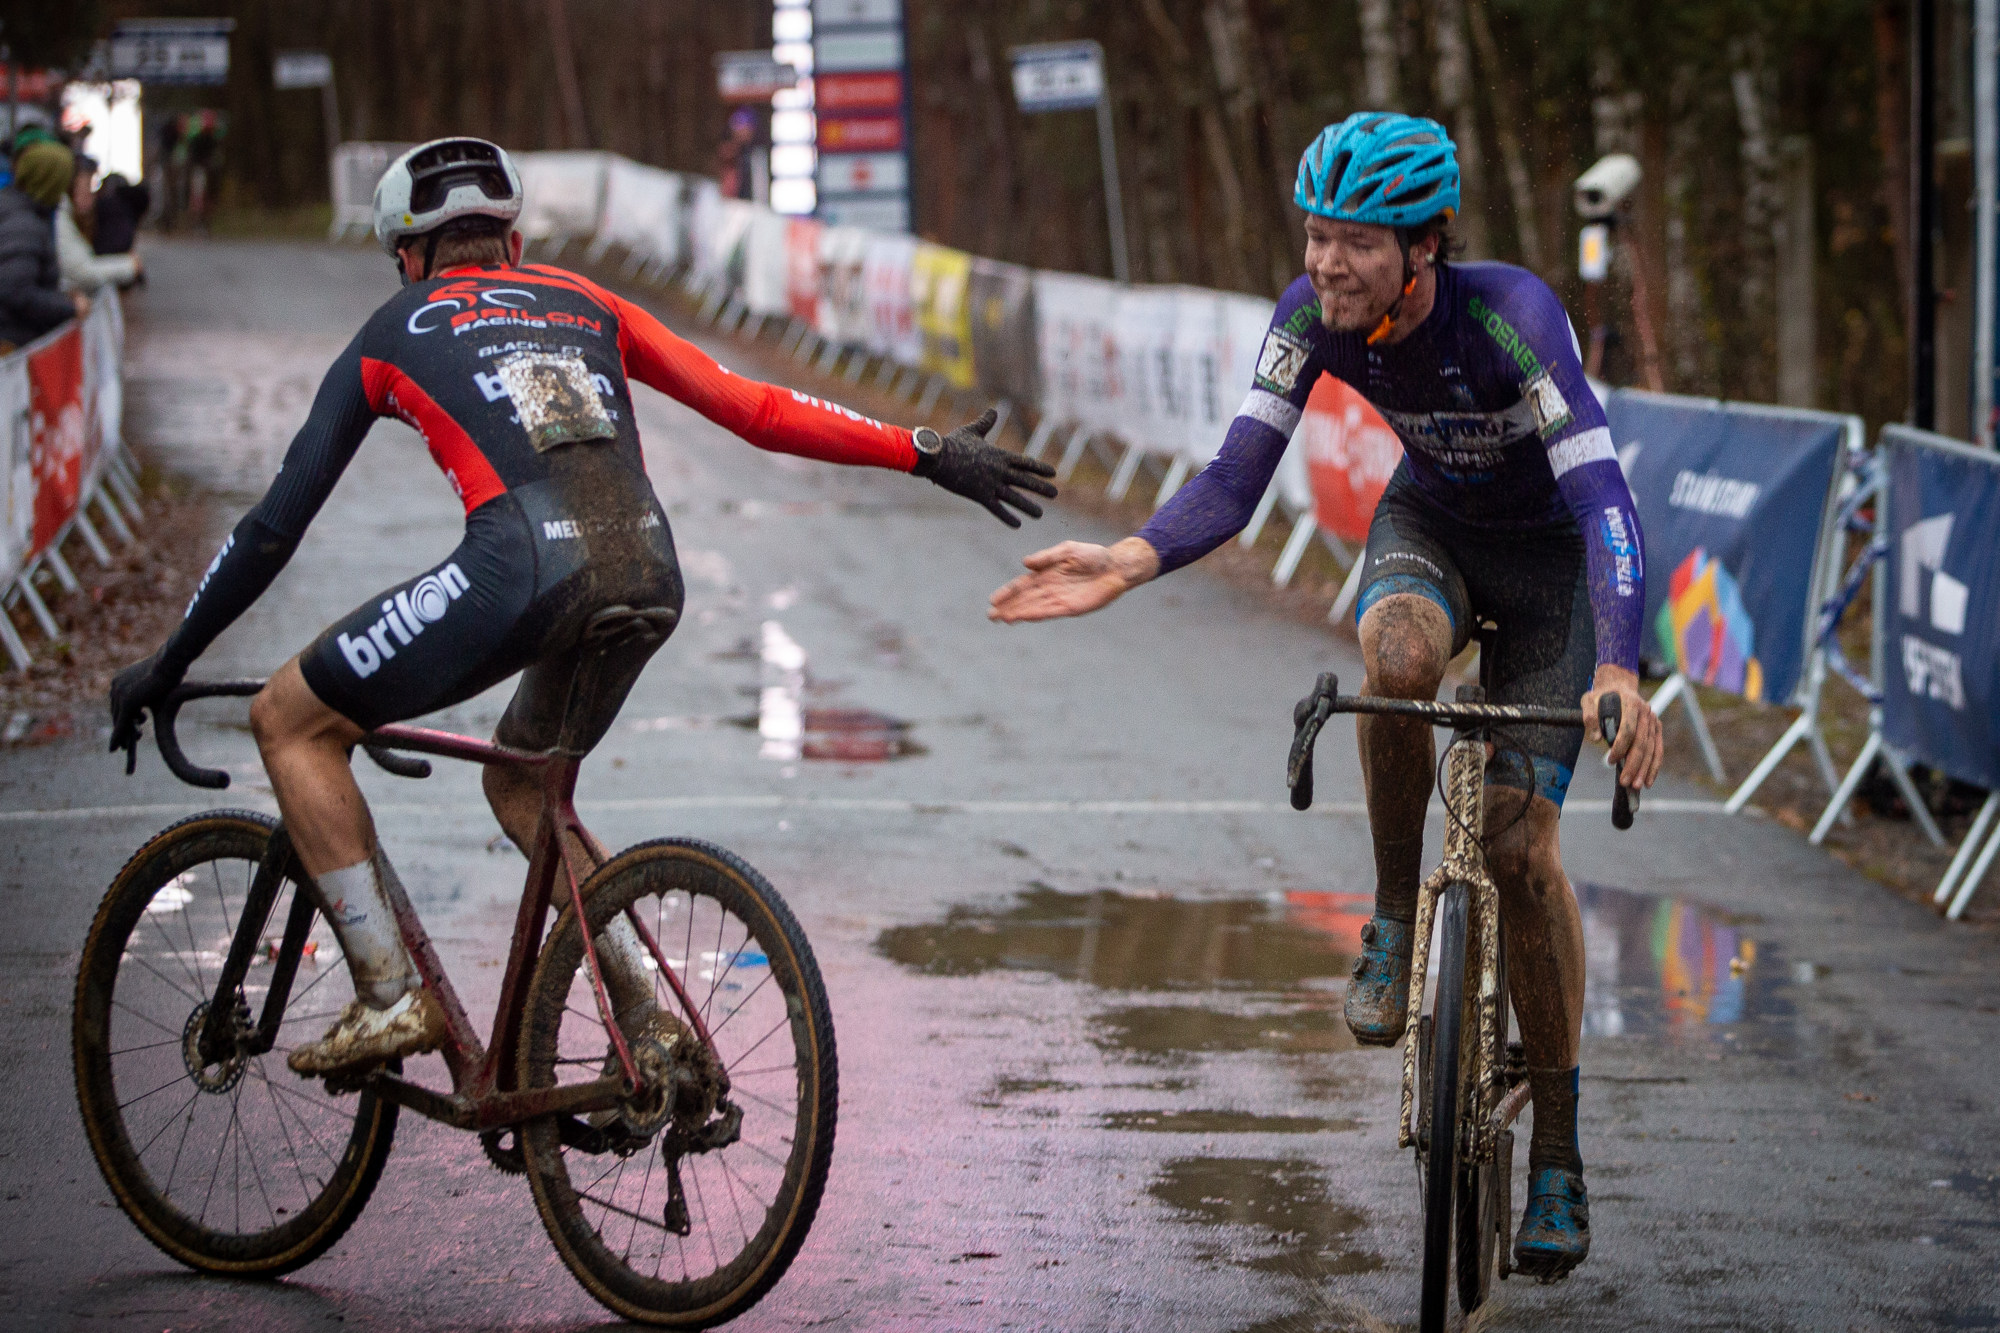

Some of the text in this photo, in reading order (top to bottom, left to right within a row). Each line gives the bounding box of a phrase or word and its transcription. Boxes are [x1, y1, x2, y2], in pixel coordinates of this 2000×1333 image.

[450, 307, 602, 332] BRILON
[453, 317, 547, 337] RACING
[1268, 343, 1293, 376] 7
[532, 363, 584, 415] 3
[336, 562, 472, 679] brilon
